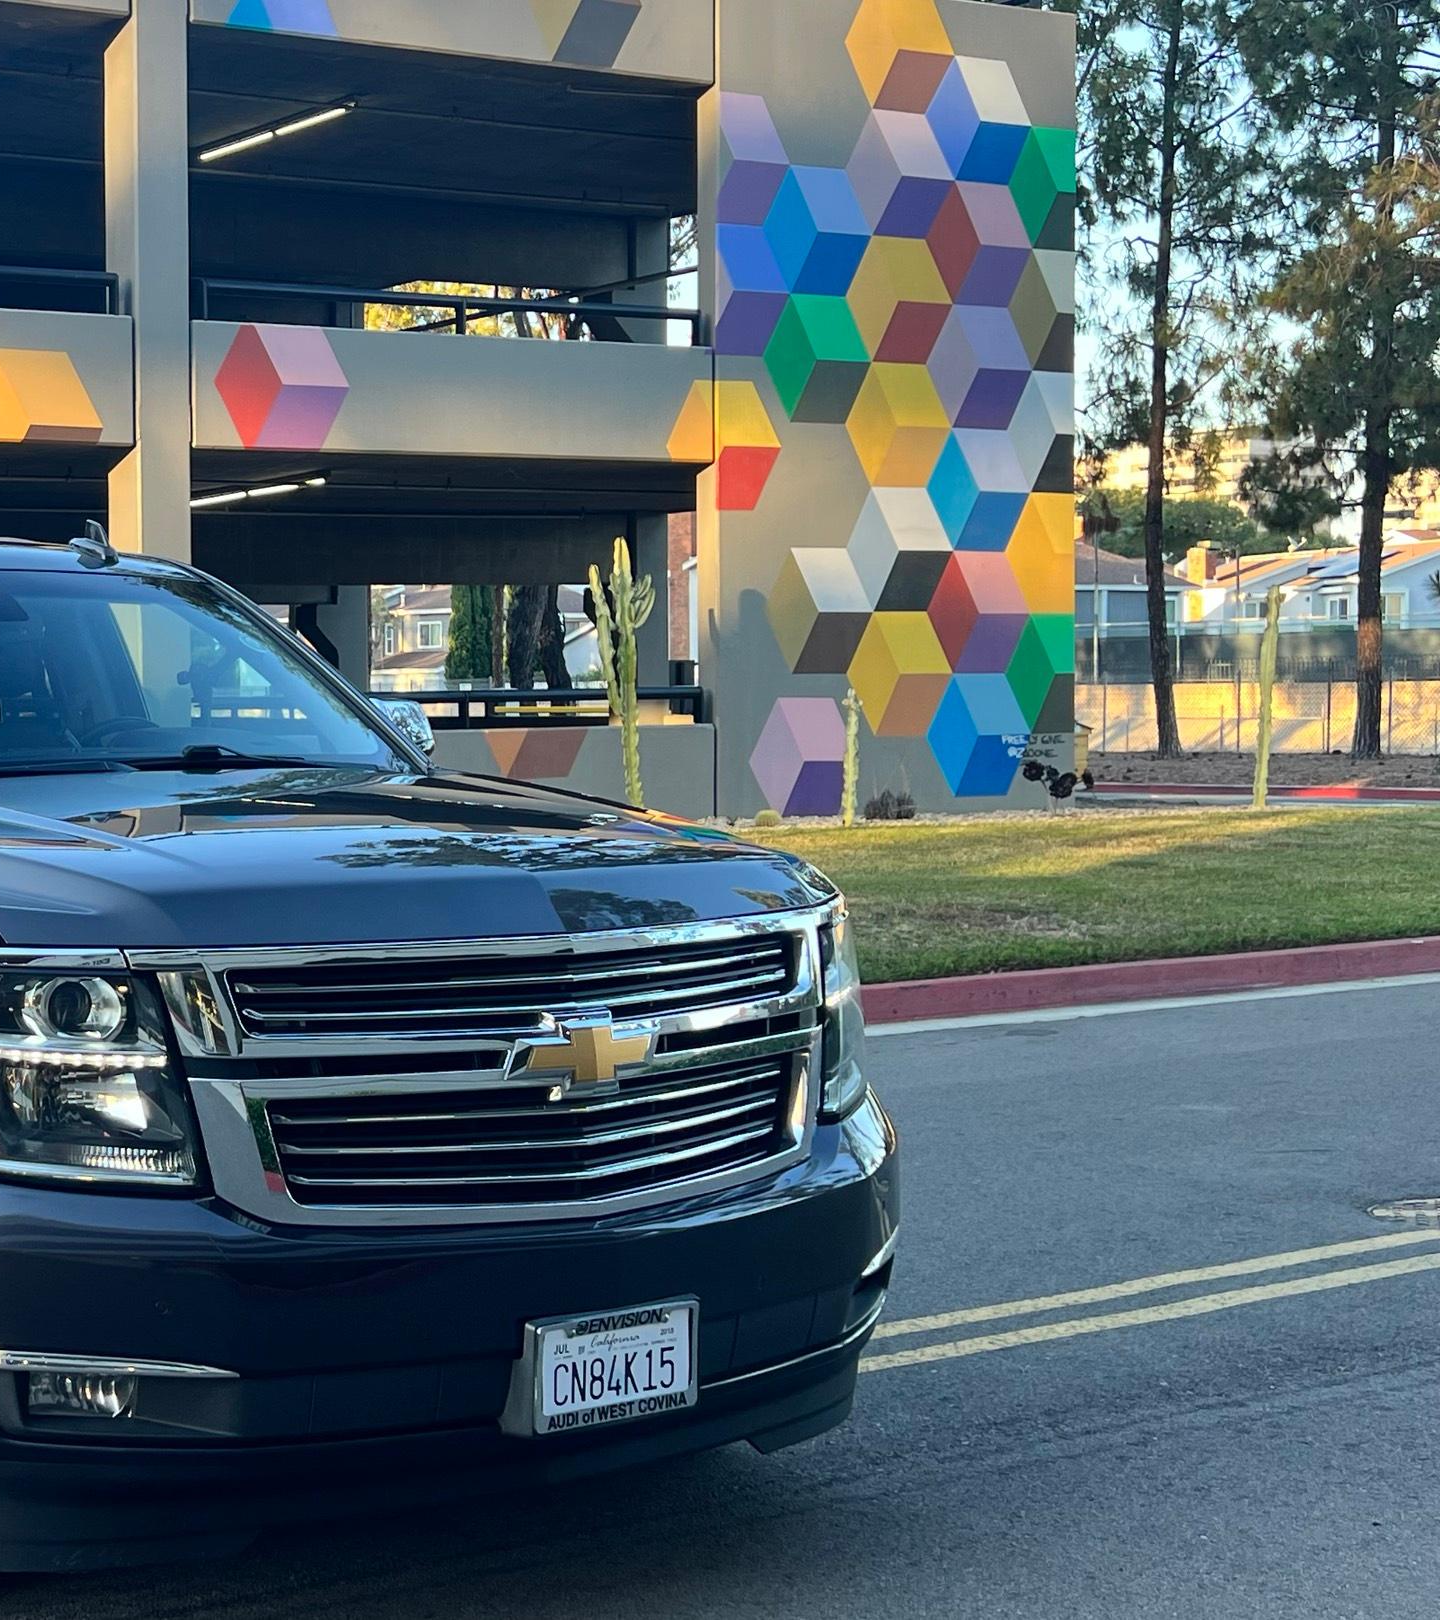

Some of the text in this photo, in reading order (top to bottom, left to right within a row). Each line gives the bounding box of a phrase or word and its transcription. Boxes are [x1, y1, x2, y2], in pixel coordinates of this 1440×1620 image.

[553, 1344, 570, 1356] JUL
[590, 1333, 640, 1351] California
[553, 1346, 675, 1406] CN84K15
[547, 1392, 688, 1431] AUDI of WEST COVINA
